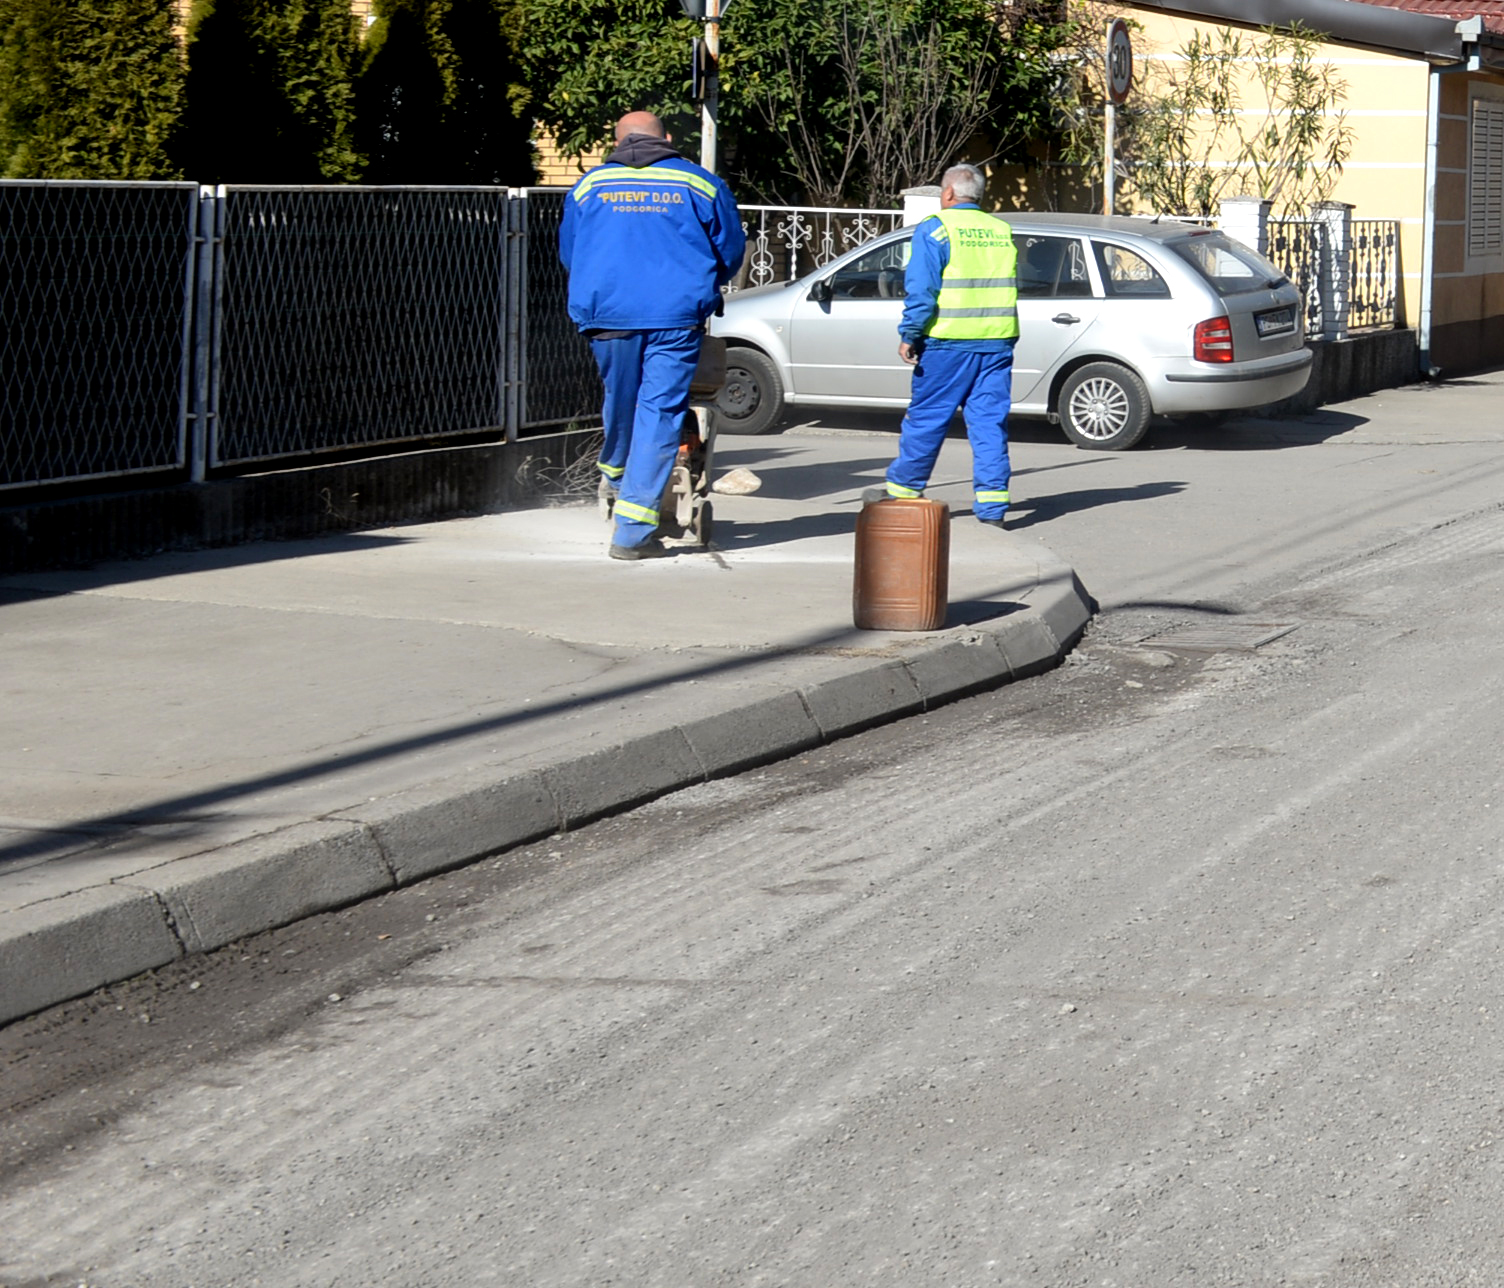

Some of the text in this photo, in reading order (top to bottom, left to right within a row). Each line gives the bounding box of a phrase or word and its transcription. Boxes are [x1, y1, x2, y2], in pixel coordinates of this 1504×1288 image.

[1113, 45, 1127, 80] 30
[652, 192, 684, 204] D.O.O.
[612, 205, 668, 213] PODGORICA
